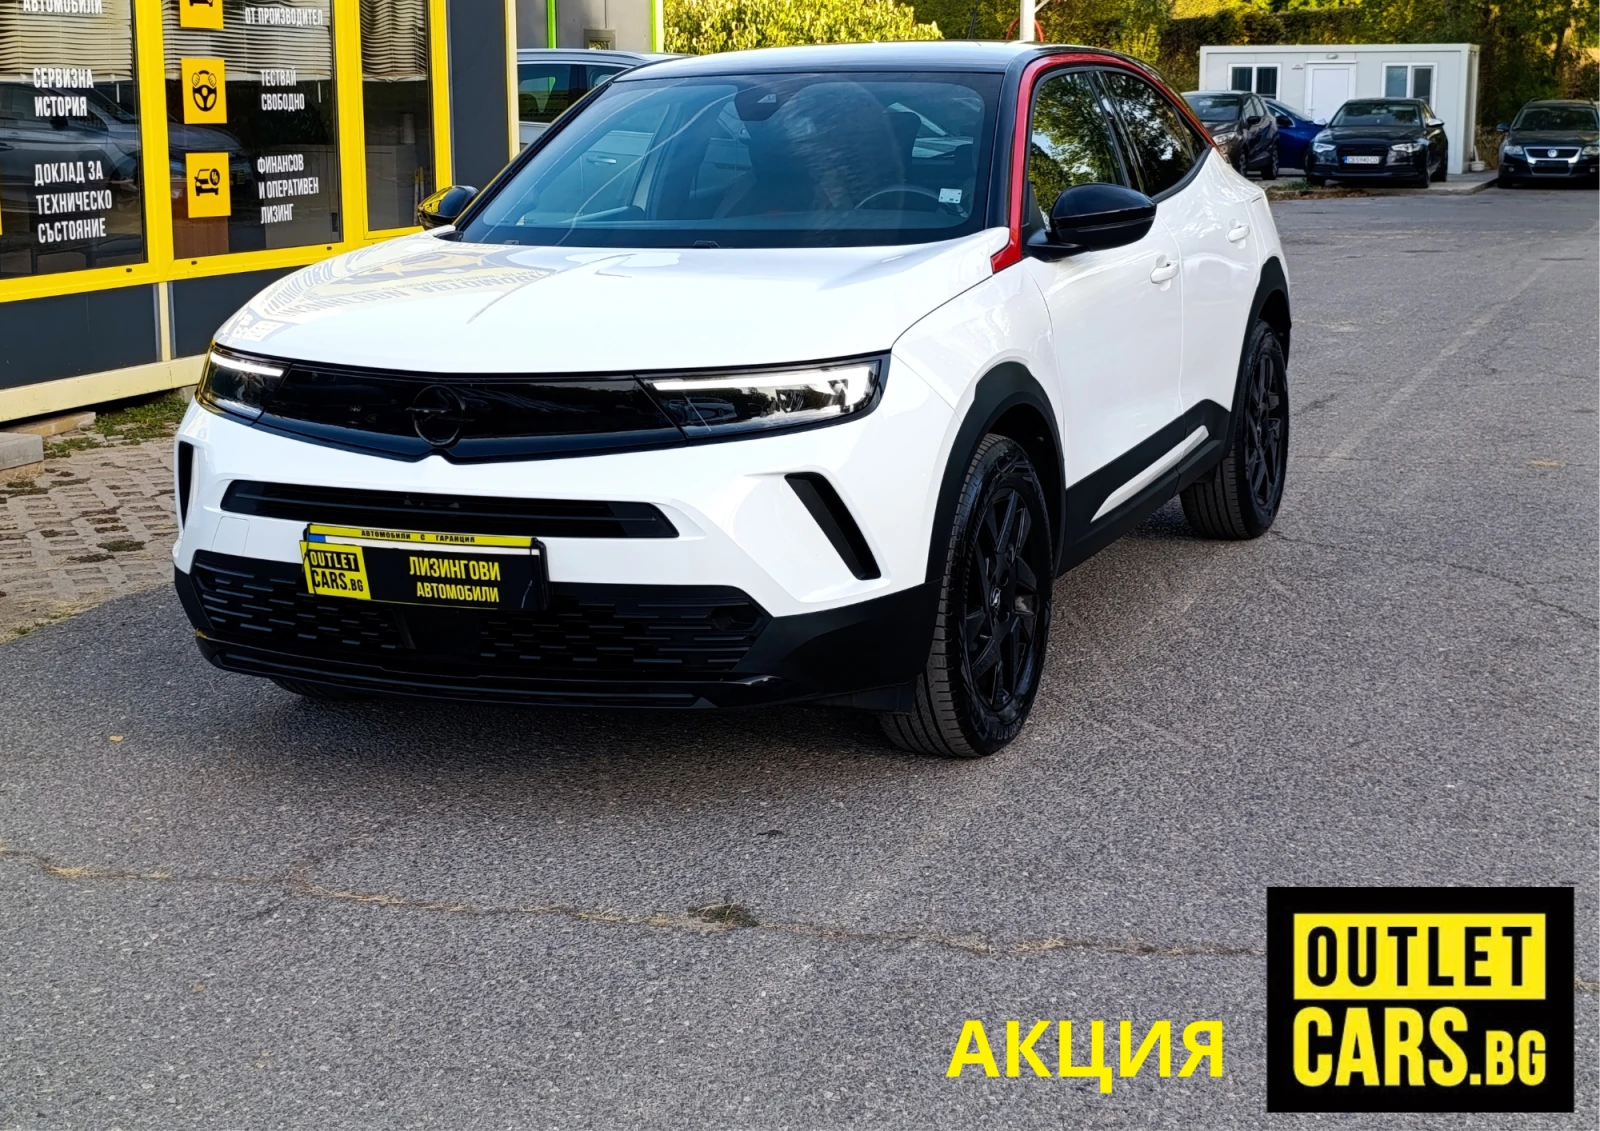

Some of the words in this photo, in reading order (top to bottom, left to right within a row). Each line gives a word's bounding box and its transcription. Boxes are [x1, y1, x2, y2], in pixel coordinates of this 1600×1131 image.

[23, 0, 103, 14] АВТОМОБИЛИ
[245, 7, 256, 24] ОТ
[257, 8, 323, 27] ПРОИЗВОДИТЕЛ
[33, 68, 94, 89] СЕРВИЗНА
[260, 67, 297, 87] ТЕСТВАЙ
[34, 96, 88, 117] ИСТОРИЯ
[261, 93, 305, 112] СВОБОДНО
[34, 161, 85, 186] ДОКЛАД
[88, 160, 104, 180] ЗА
[257, 154, 304, 175] ФИНАНСОВ
[258, 182, 265, 199] И
[266, 177, 320, 199] ОПЕРАТИВЕН
[36, 190, 113, 216] ТЕХНИЧЕСКО
[260, 203, 294, 225] ЛИЗИНГ
[38, 218, 107, 244] СЪСТОЯНИЕ
[361, 530, 411, 540] АВТОМОБИЛИ
[436, 534, 475, 544] ГАРАНЦИЯ
[310, 551, 356, 569] OUTLET
[409, 556, 501, 581] ЛИЗИНГОВИ
[311, 569, 364, 592] CARS.BG
[416, 581, 500, 603] АВТОМОБИЛИ
